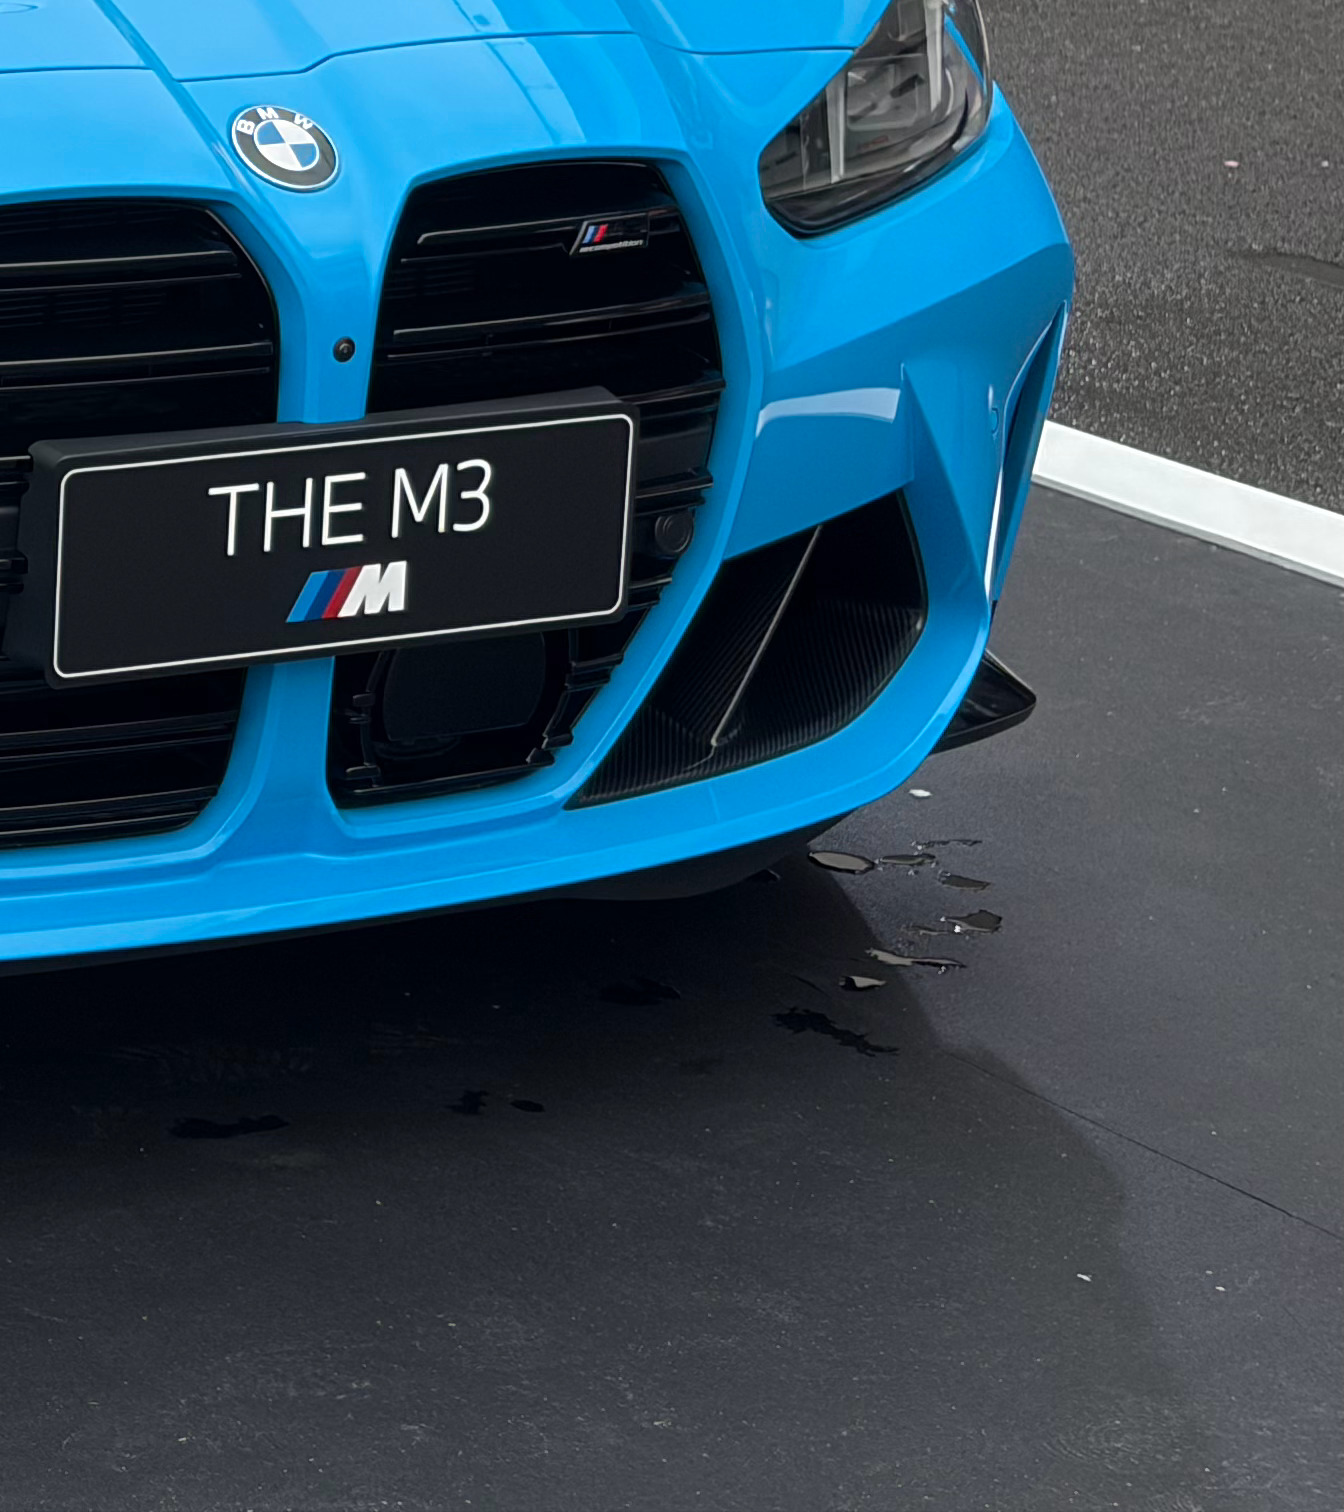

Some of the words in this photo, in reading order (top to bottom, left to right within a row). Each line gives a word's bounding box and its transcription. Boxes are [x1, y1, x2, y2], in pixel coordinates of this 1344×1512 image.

[236, 106, 313, 136] BMW
[208, 472, 367, 556] THE
[391, 458, 493, 539] M3
[337, 560, 408, 619] M
